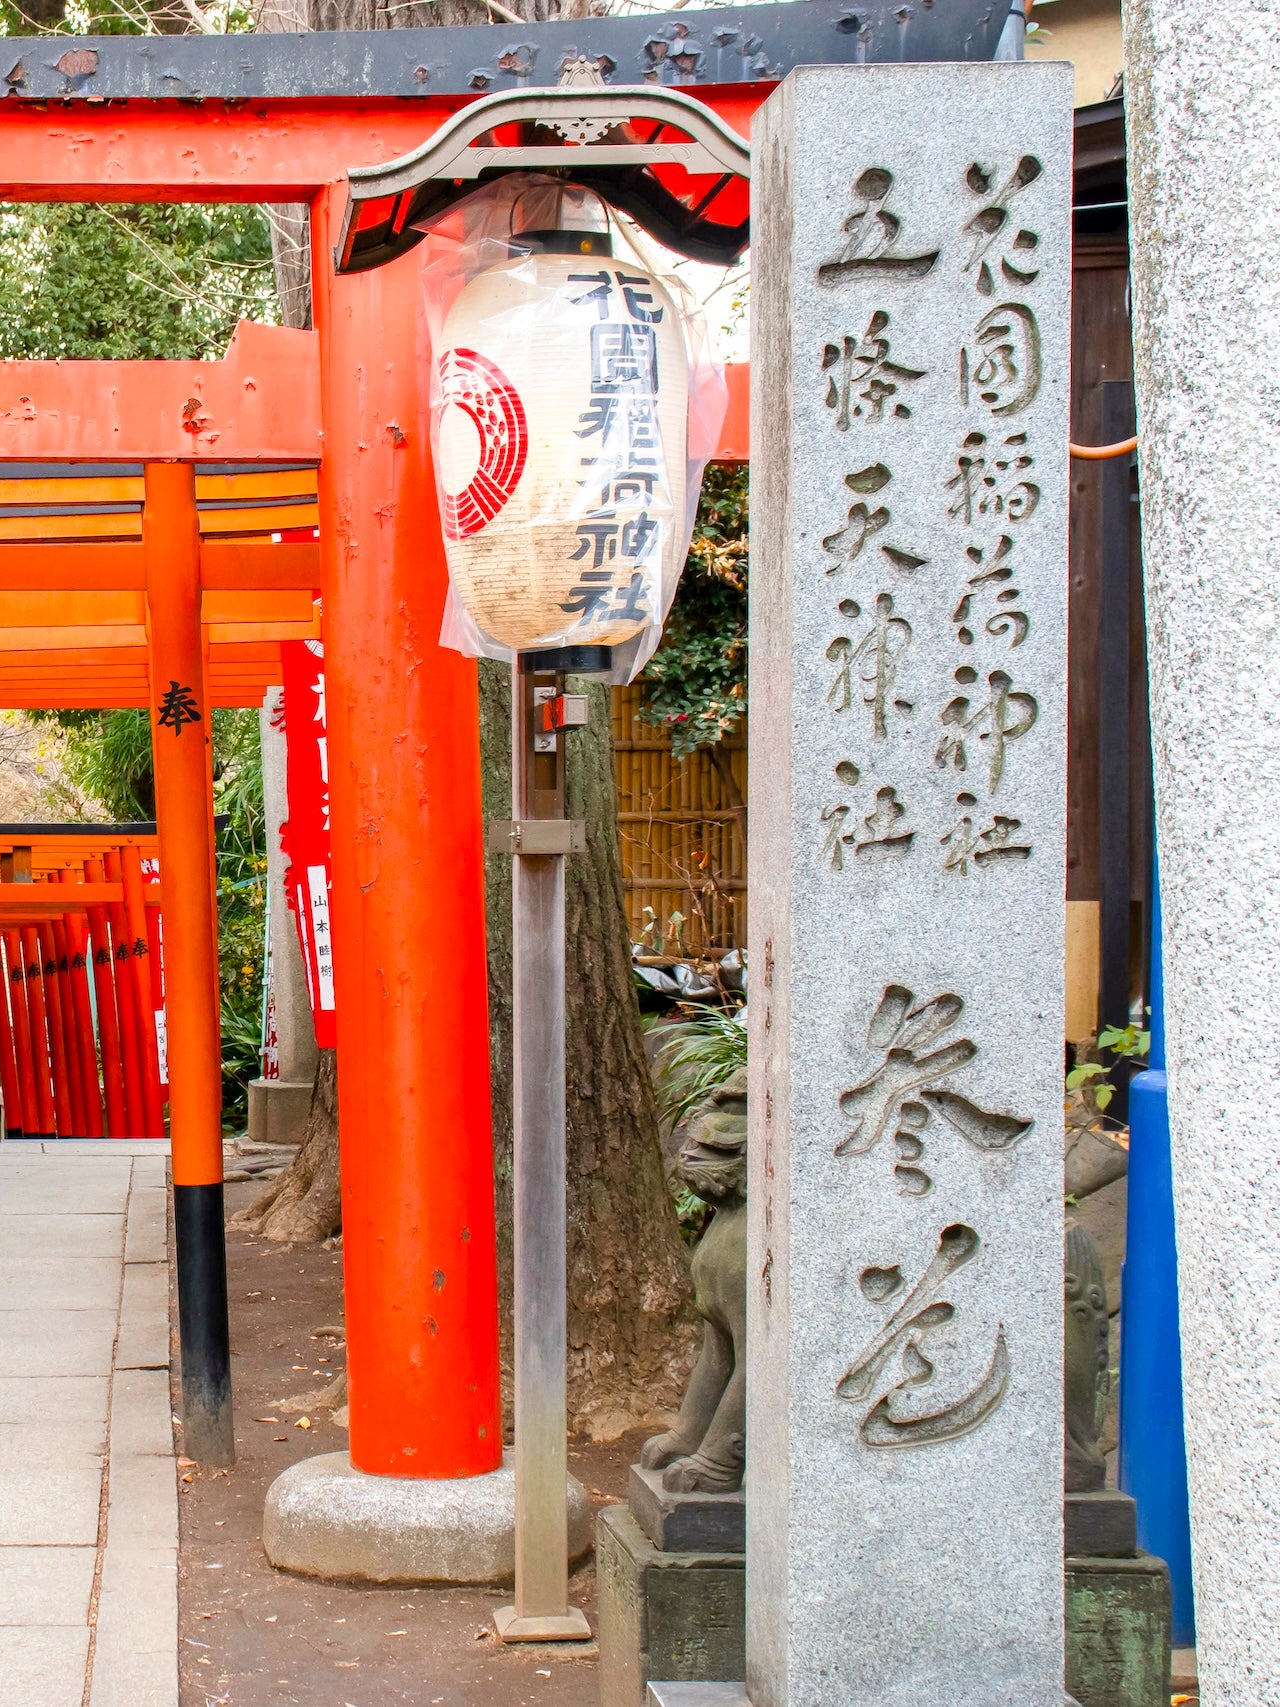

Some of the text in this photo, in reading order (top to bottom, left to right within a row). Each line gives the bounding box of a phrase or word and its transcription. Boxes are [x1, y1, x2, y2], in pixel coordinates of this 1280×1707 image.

[157, 681, 201, 737] 奉
[132, 937, 149, 959] 奉
[833, 984, 1034, 1450] 参道
